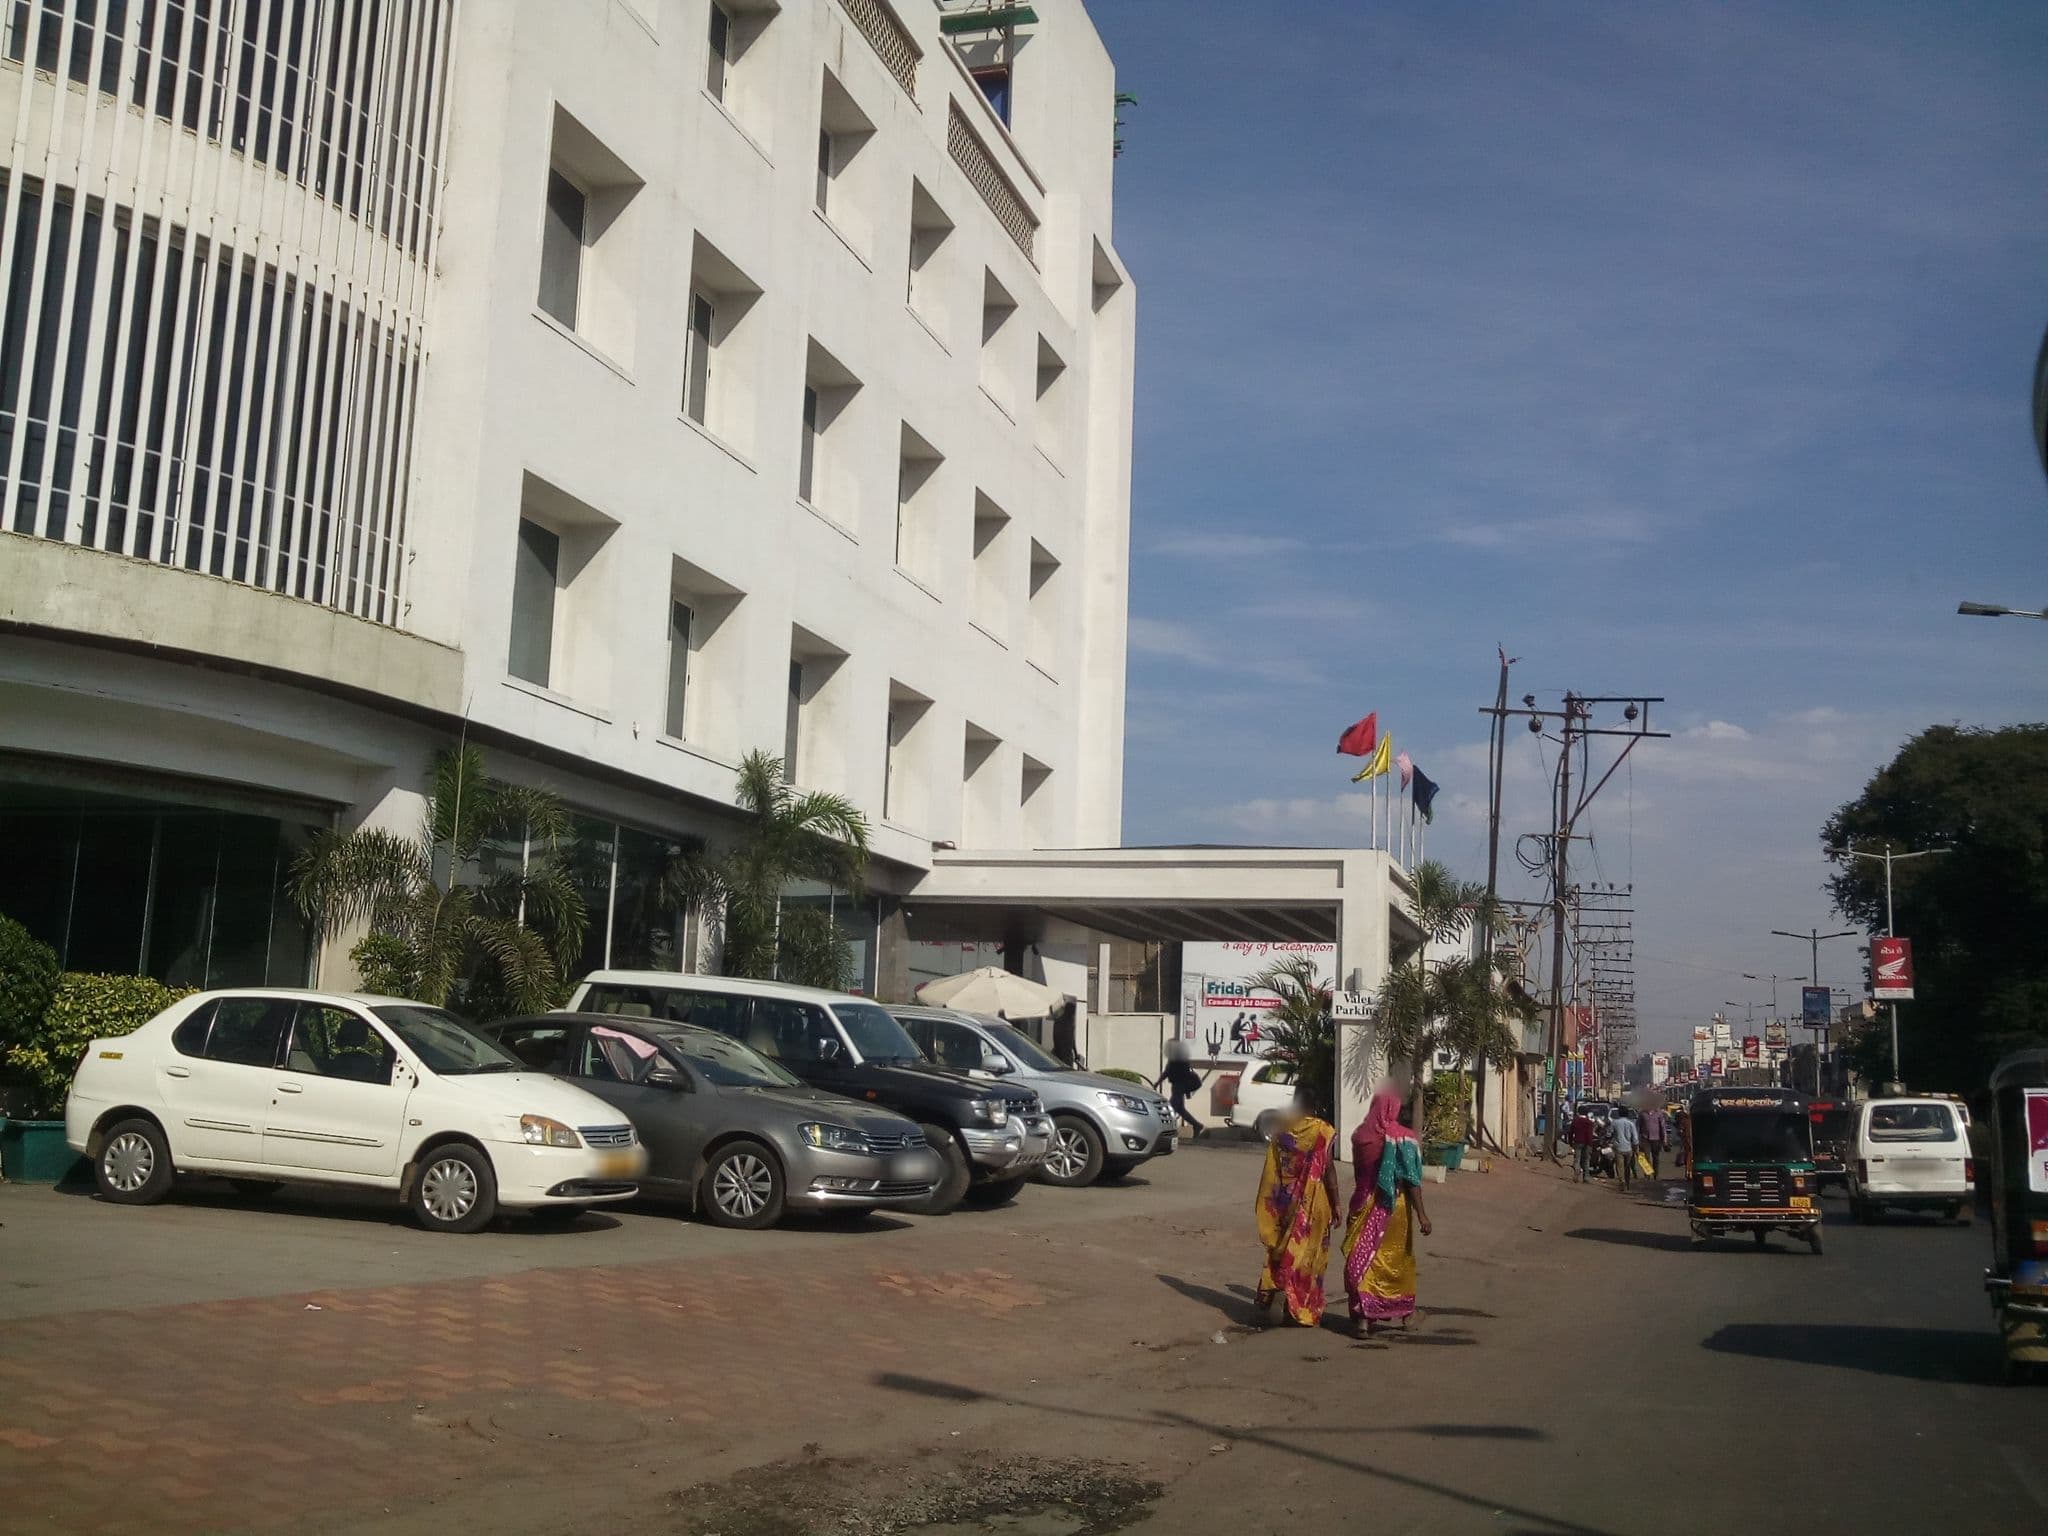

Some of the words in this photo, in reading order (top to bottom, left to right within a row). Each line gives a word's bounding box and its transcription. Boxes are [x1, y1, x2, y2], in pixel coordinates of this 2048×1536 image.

[1256, 942, 1268, 957] of
[1207, 981, 1251, 997] Friday
[1234, 999, 1253, 1008] Light
[1344, 993, 1371, 1004] Valet
[1335, 1005, 1377, 1016] Parkin
